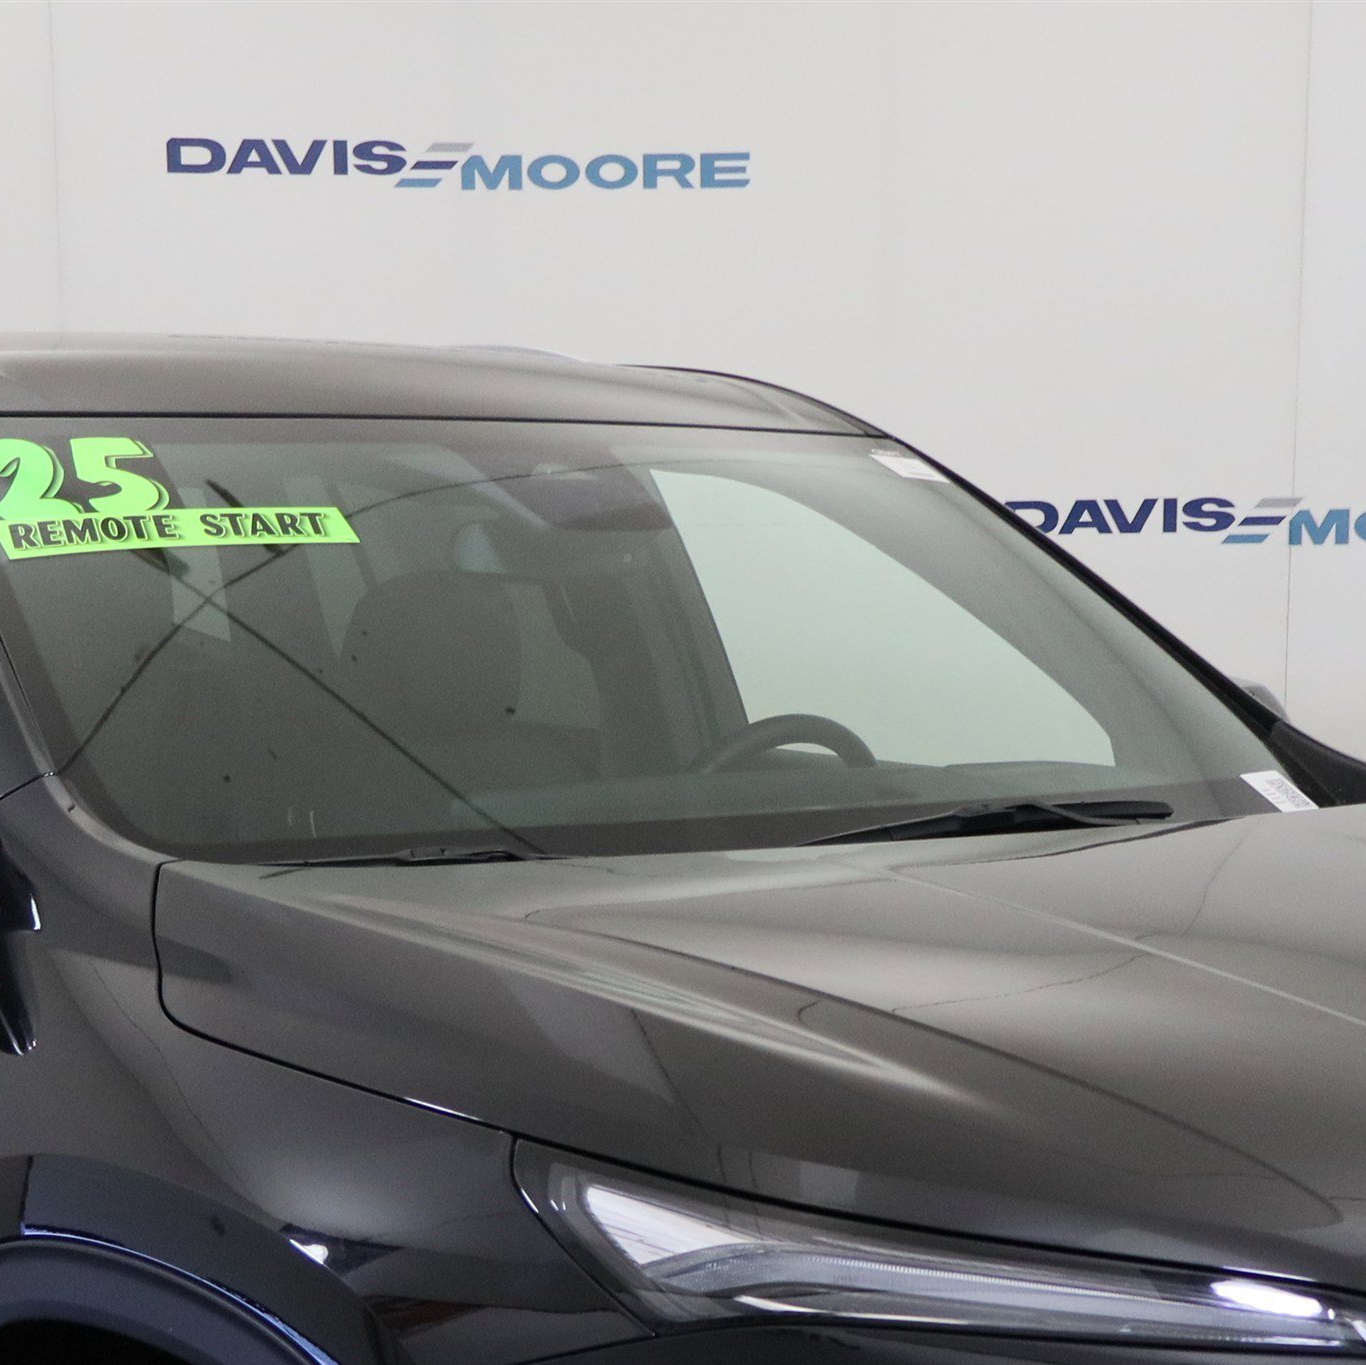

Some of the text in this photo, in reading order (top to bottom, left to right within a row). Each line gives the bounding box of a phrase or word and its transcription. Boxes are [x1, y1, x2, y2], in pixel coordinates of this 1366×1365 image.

[166, 138, 751, 191] DAVIS MOORE
[8, 511, 327, 550] REMOTE START
